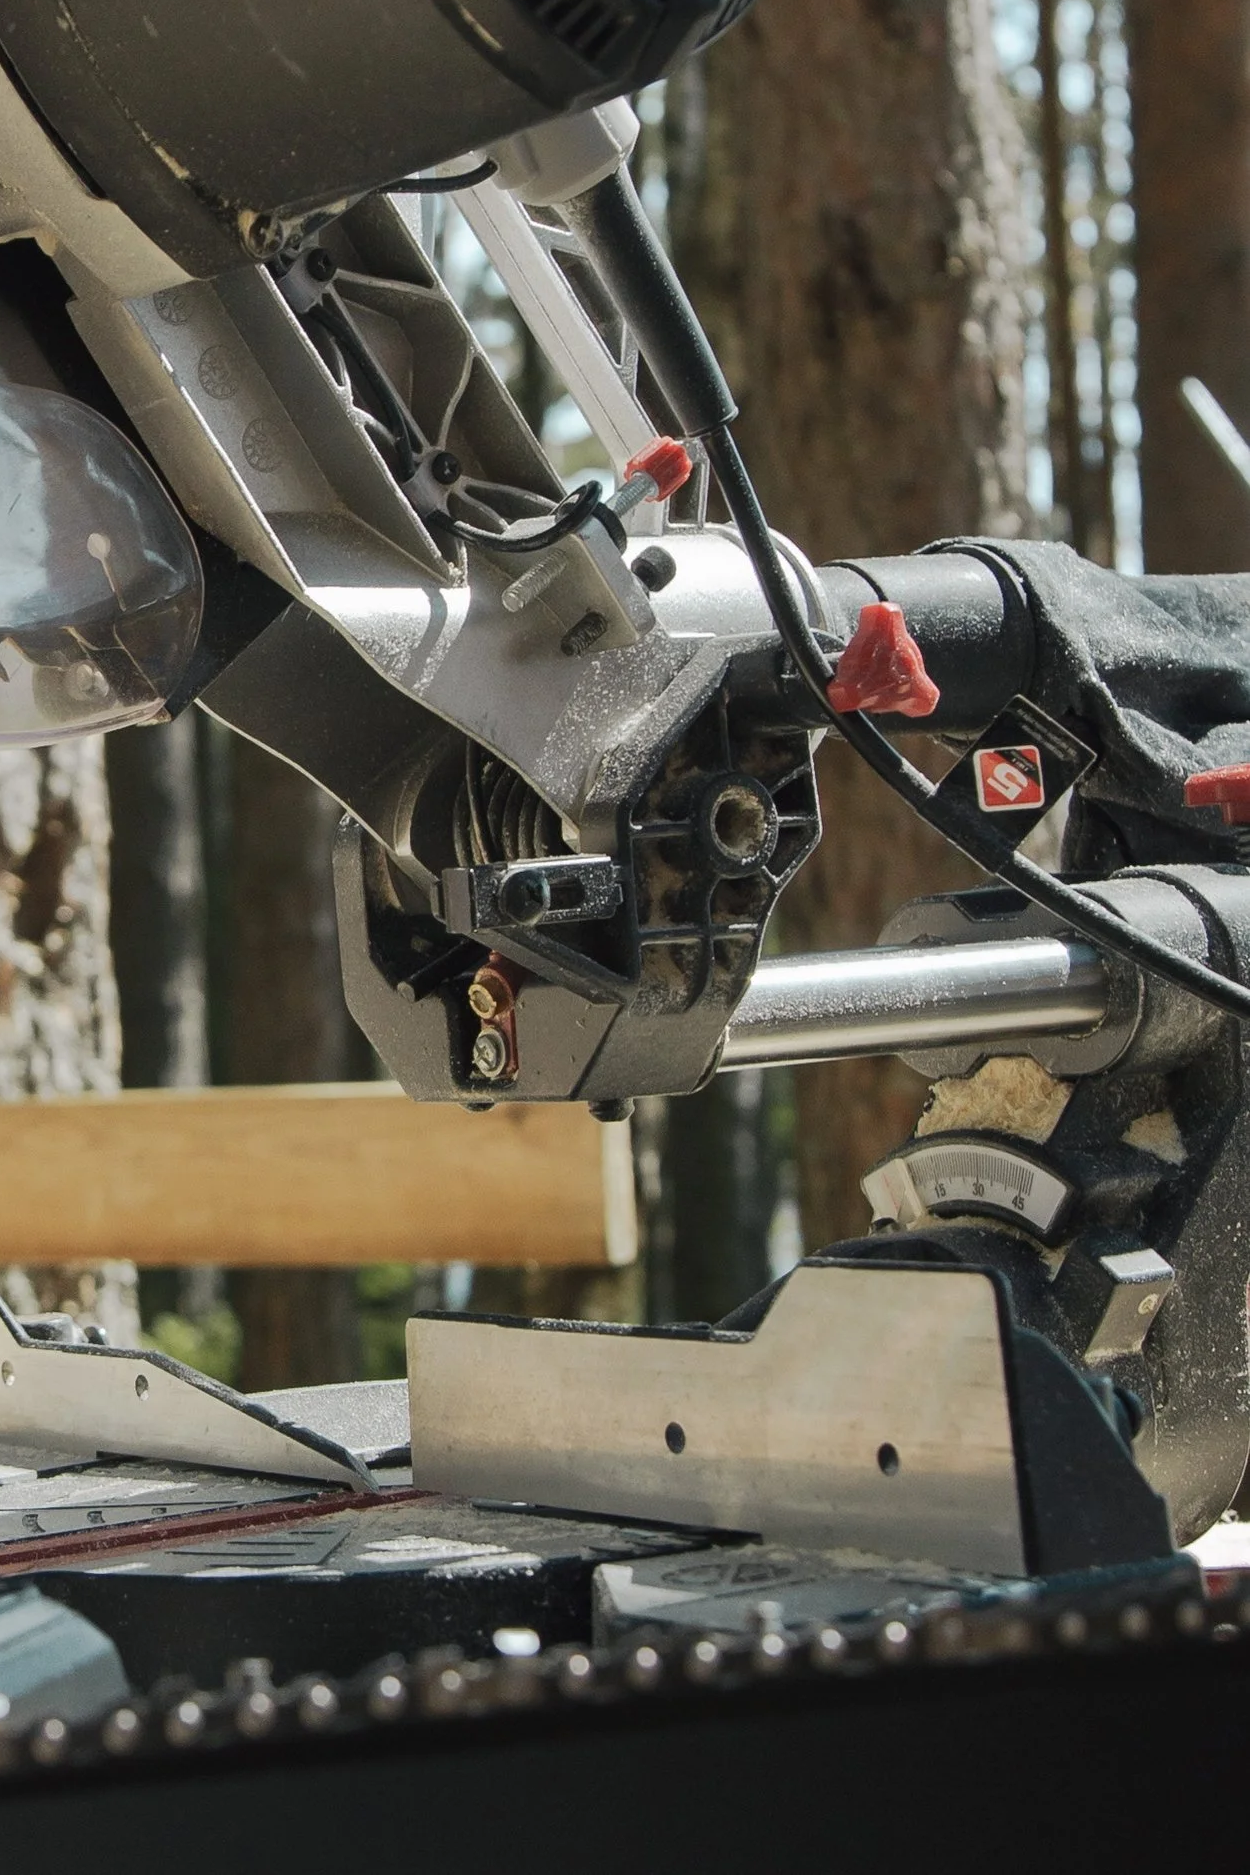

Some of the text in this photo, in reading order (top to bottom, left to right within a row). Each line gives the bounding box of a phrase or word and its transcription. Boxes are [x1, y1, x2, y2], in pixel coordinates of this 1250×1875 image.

[987, 762, 1029, 802] 5
[934, 1182, 1025, 1211] 15 30 45
